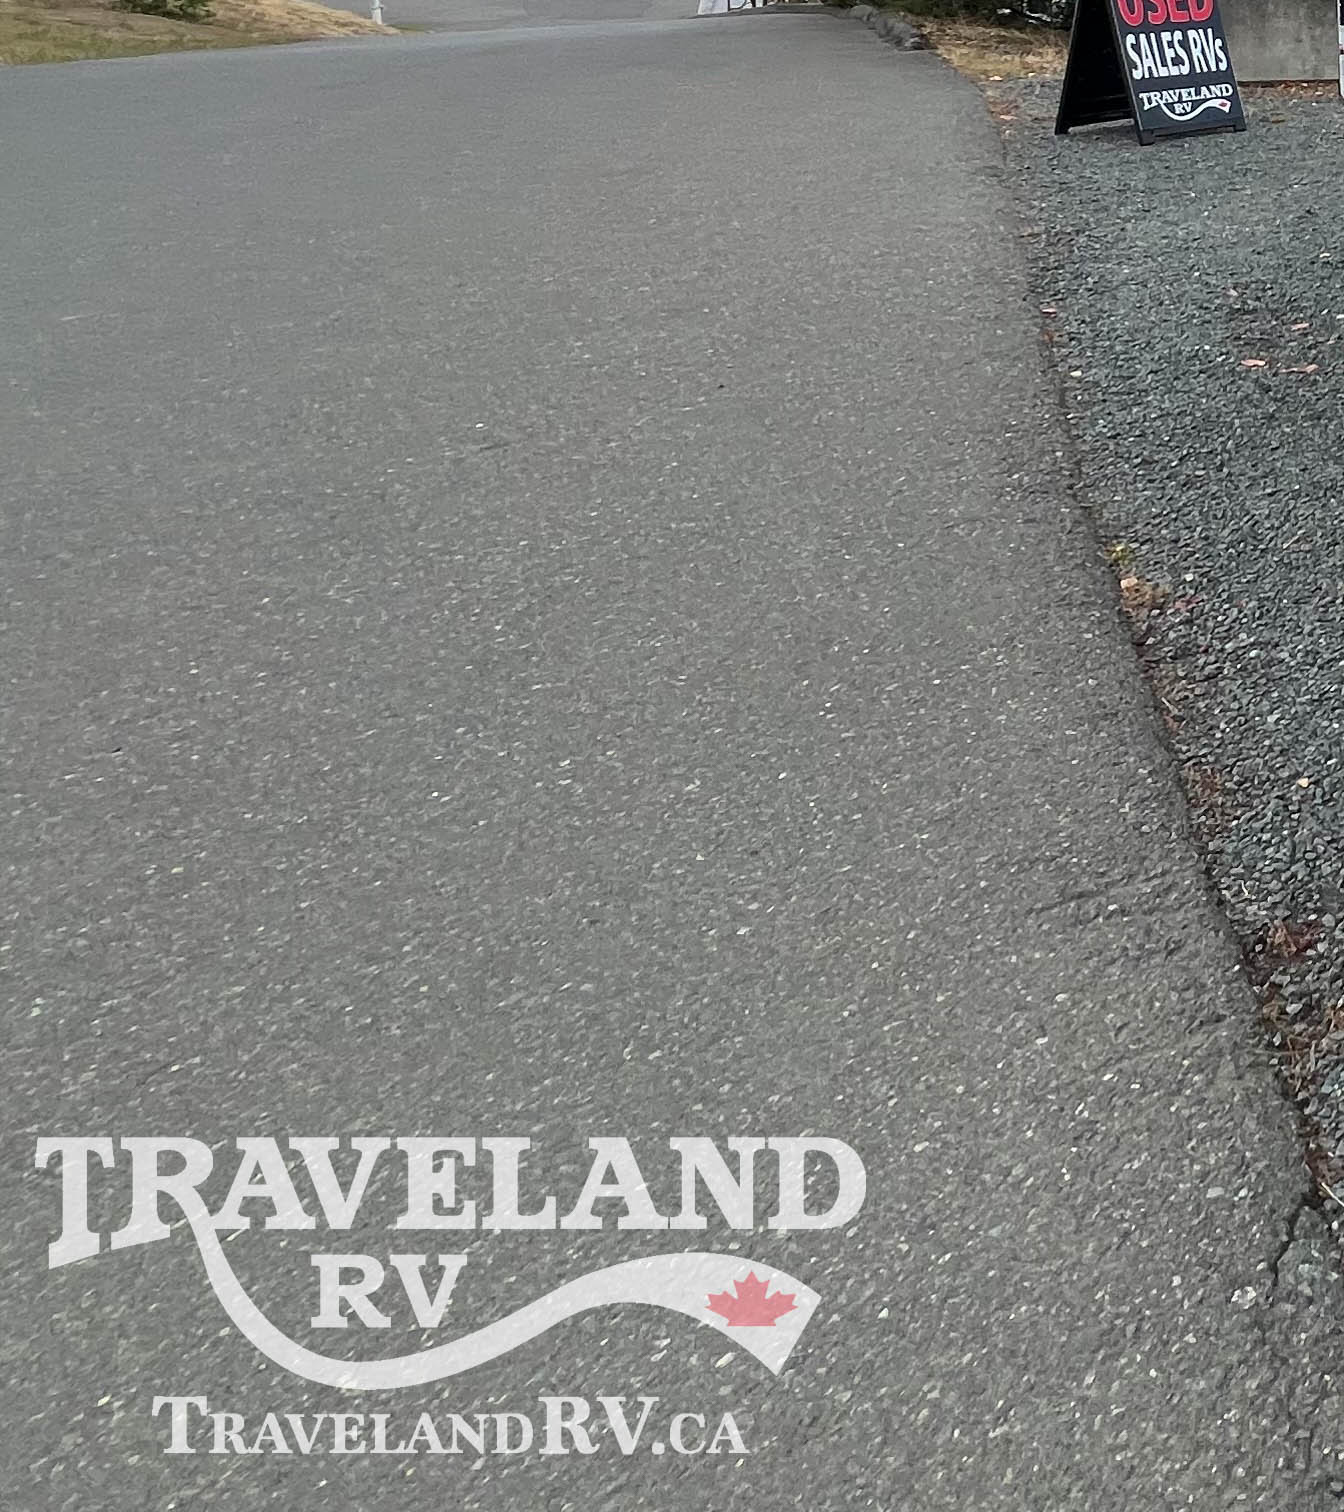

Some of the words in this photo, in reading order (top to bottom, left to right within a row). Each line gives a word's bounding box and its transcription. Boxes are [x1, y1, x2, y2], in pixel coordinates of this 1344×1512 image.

[1126, 30, 1190, 80] SALES
[1187, 28, 1228, 73] RVs
[1139, 83, 1234, 111] TRAVELAND
[1174, 101, 1194, 115] RV
